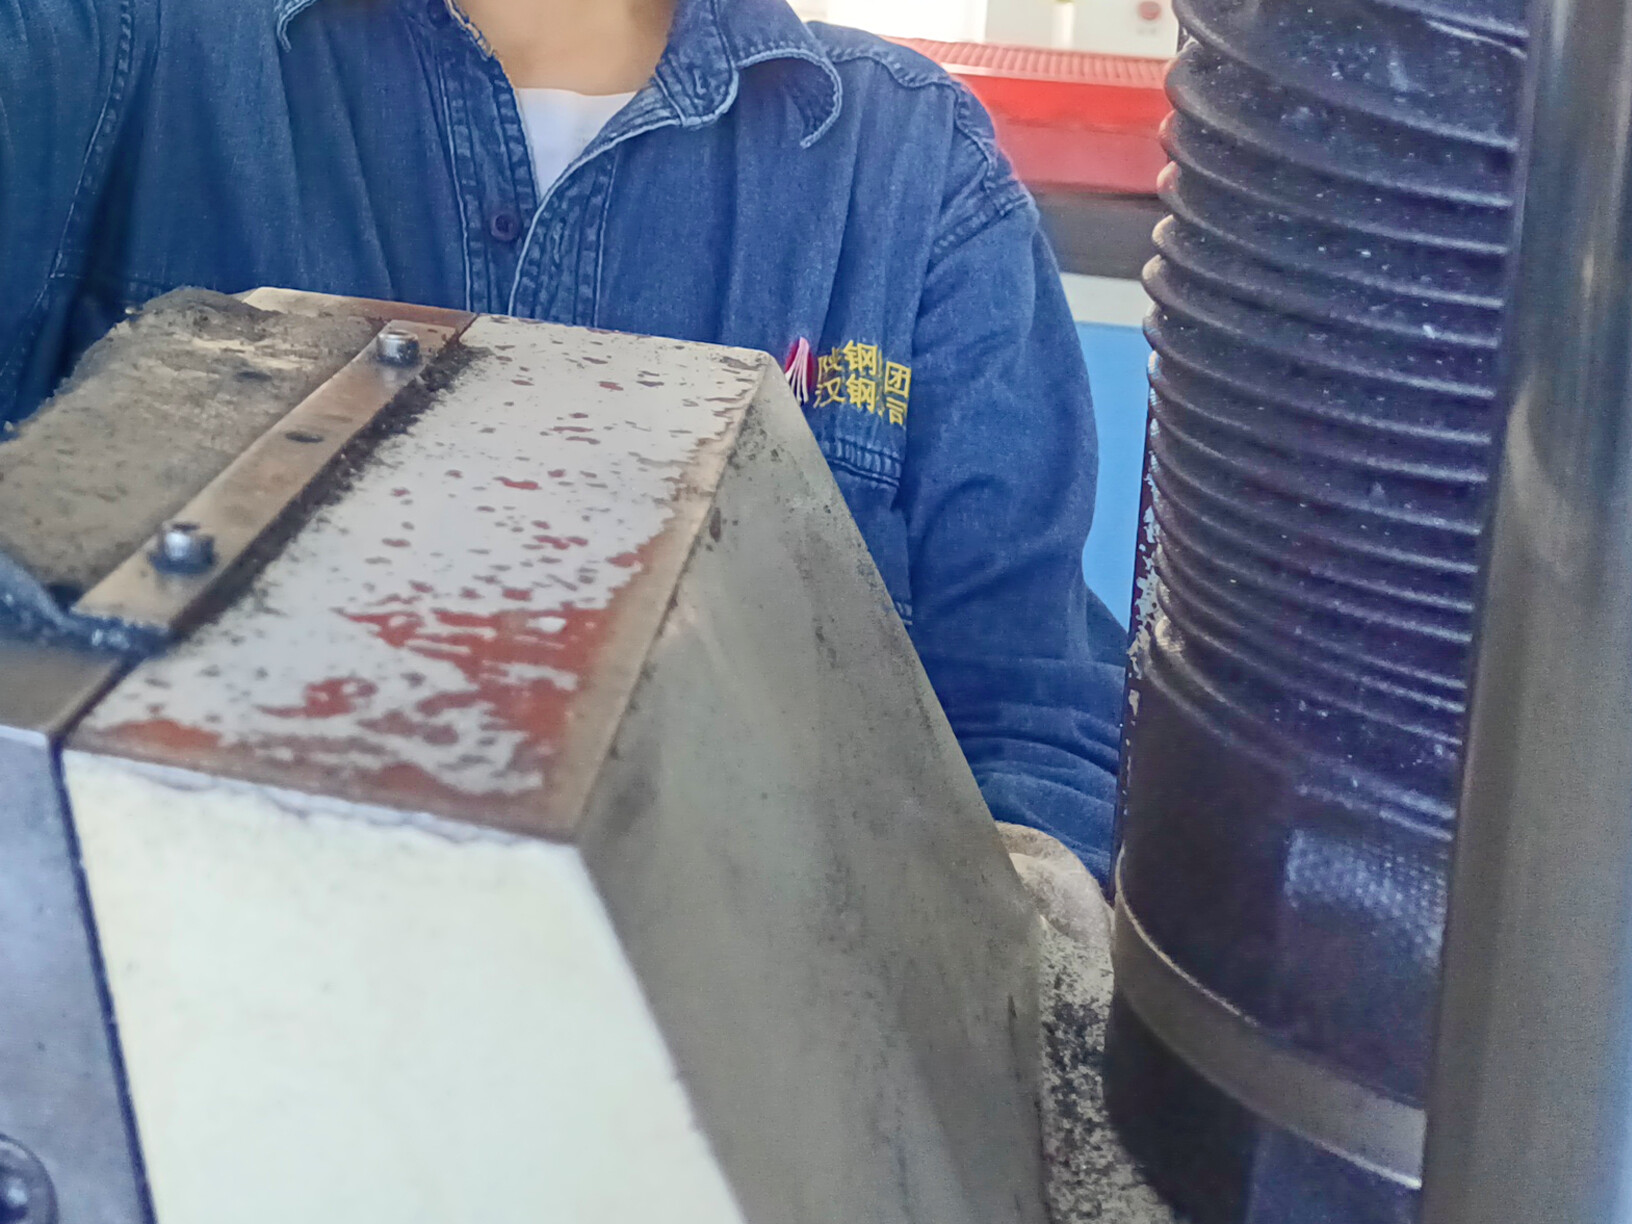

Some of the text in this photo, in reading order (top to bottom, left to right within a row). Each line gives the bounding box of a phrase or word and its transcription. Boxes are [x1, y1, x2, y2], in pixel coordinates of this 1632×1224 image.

[817, 340, 911, 398] 陕钢团
[813, 374, 907, 426] 汉钢司
